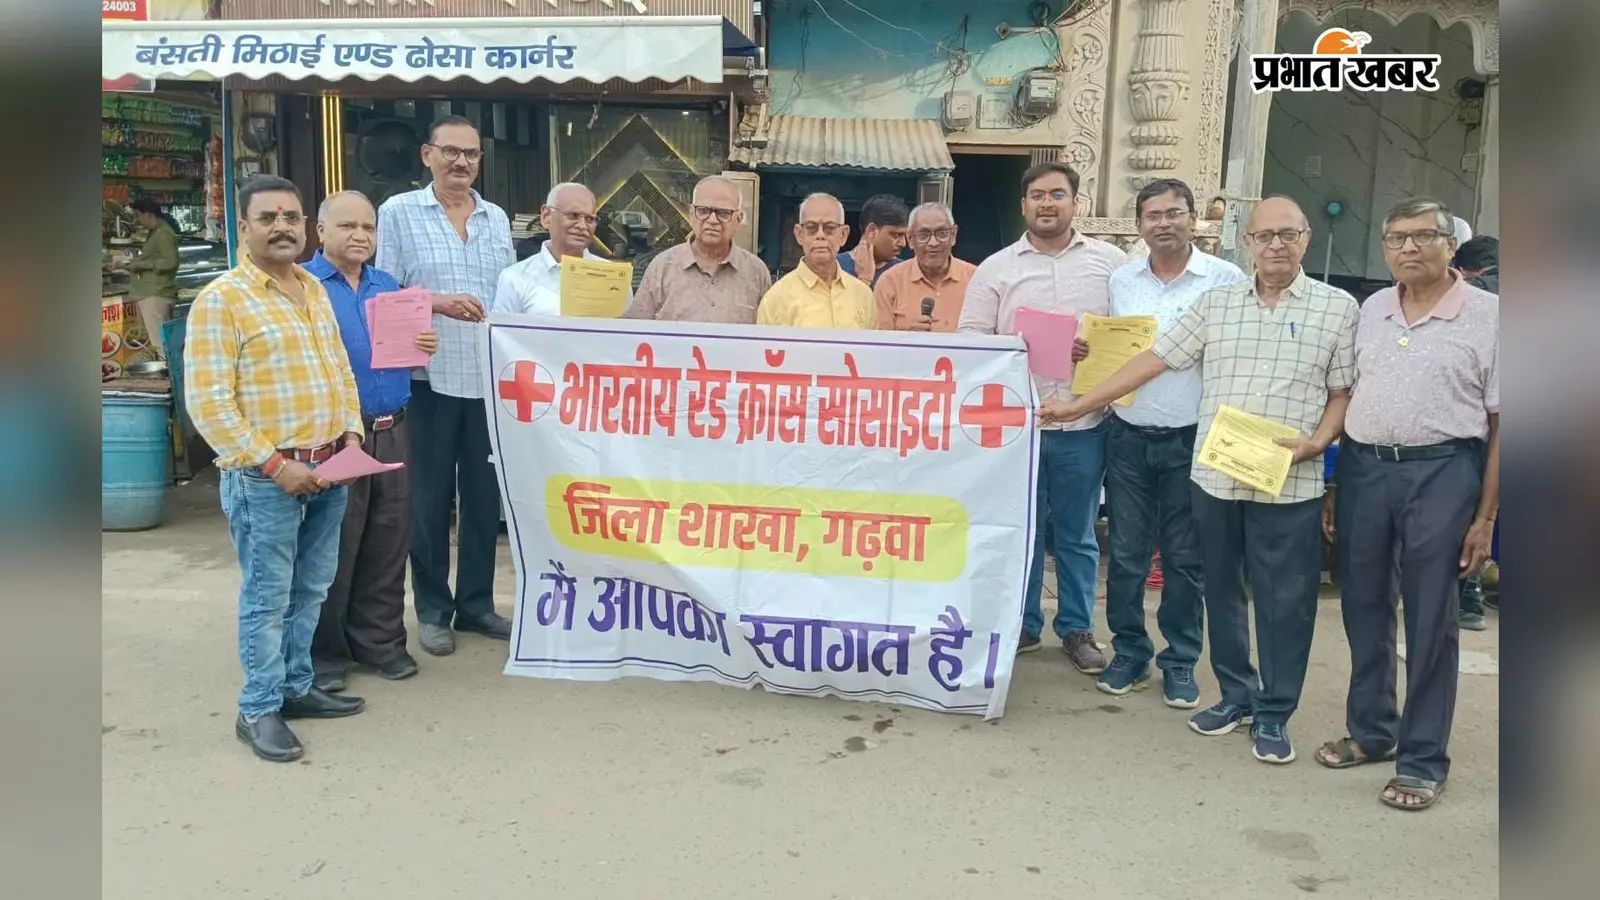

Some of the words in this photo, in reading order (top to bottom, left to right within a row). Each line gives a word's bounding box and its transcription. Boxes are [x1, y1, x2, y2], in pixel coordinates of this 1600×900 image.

[135, 33, 225, 66] बंसती
[232, 34, 326, 69] मिठाई
[333, 43, 397, 69] एण्ड
[405, 36, 476, 69] ढोसा
[484, 35, 578, 70] कार्नर
[559, 343, 682, 435] भारतीय
[687, 346, 732, 440] रेड
[736, 349, 812, 445] क्रॉस
[817, 353, 957, 458] सोसाइटी
[563, 481, 669, 545] जिला
[678, 503, 809, 563] शाखा,
[822, 510, 931, 572] गढ़वा
[536, 558, 578, 632] में
[587, 576, 731, 657] आपका
[740, 614, 916, 677] स्वागत
